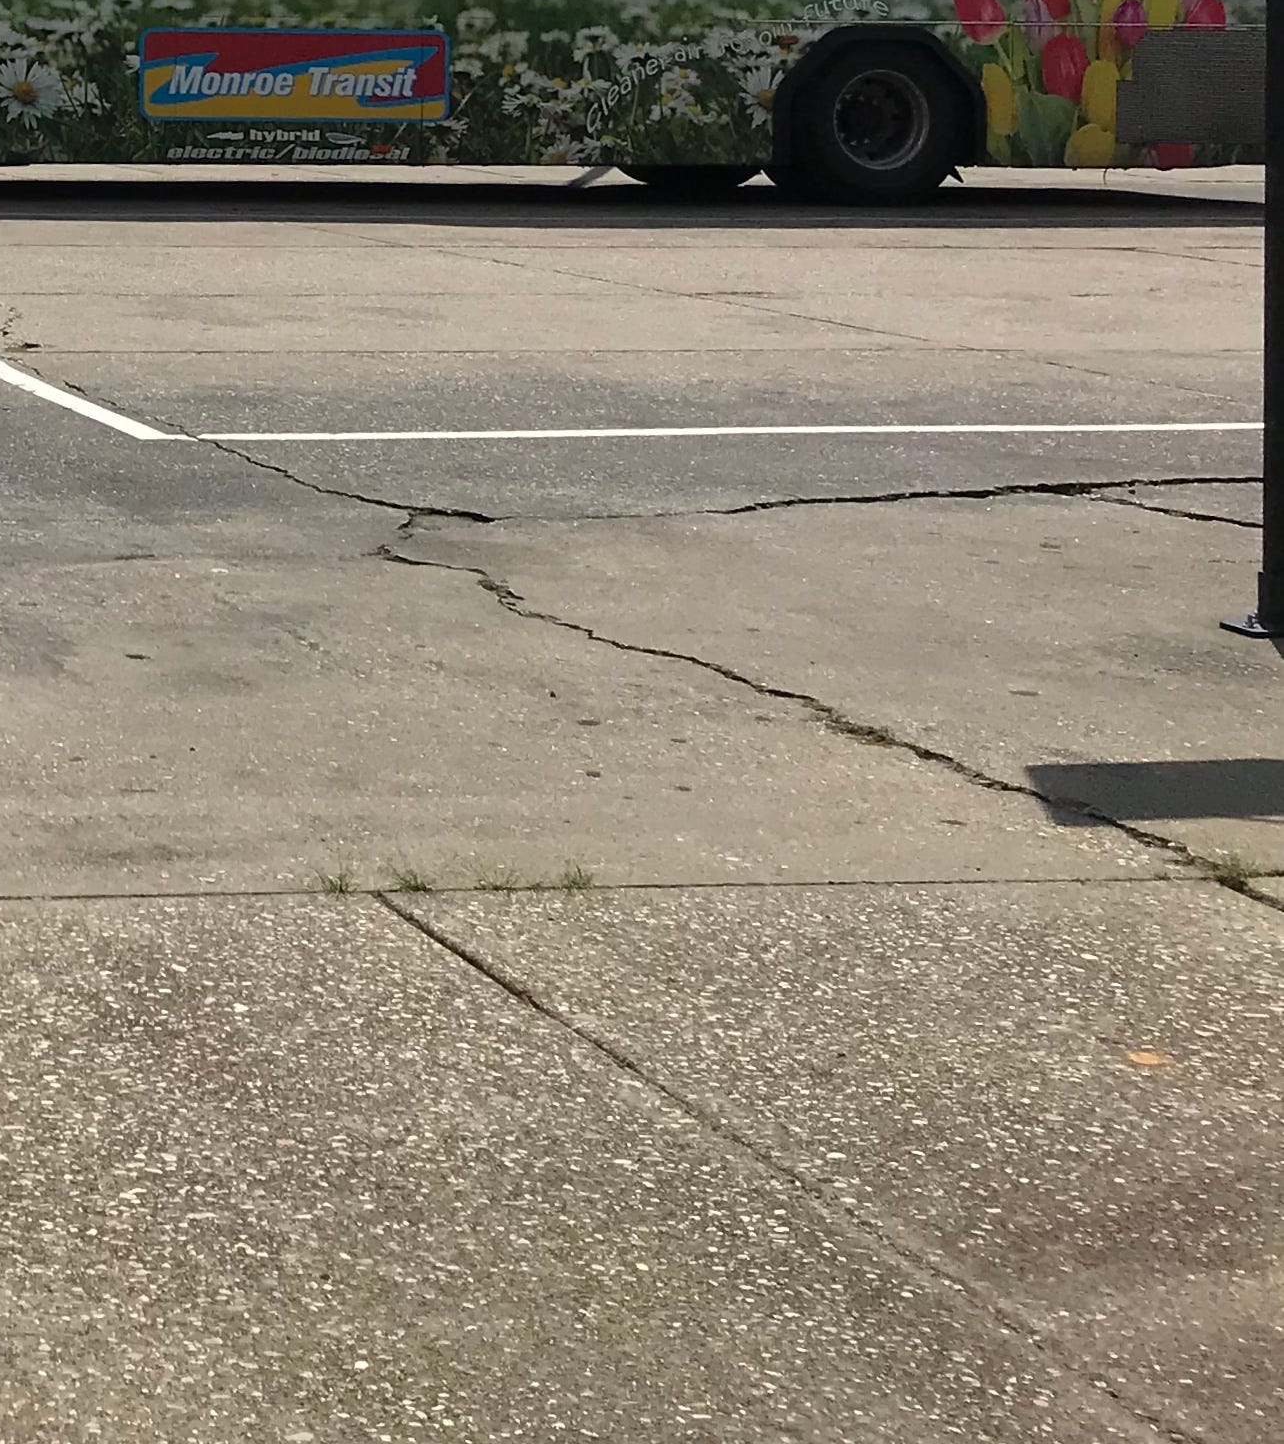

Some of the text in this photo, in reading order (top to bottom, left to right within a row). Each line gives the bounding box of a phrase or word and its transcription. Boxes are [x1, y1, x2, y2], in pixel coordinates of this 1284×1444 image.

[168, 64, 417, 97] Monroe Transit
[586, 56, 667, 135] Cleaner
[674, 35, 703, 62] air
[249, 128, 321, 143] hybrid
